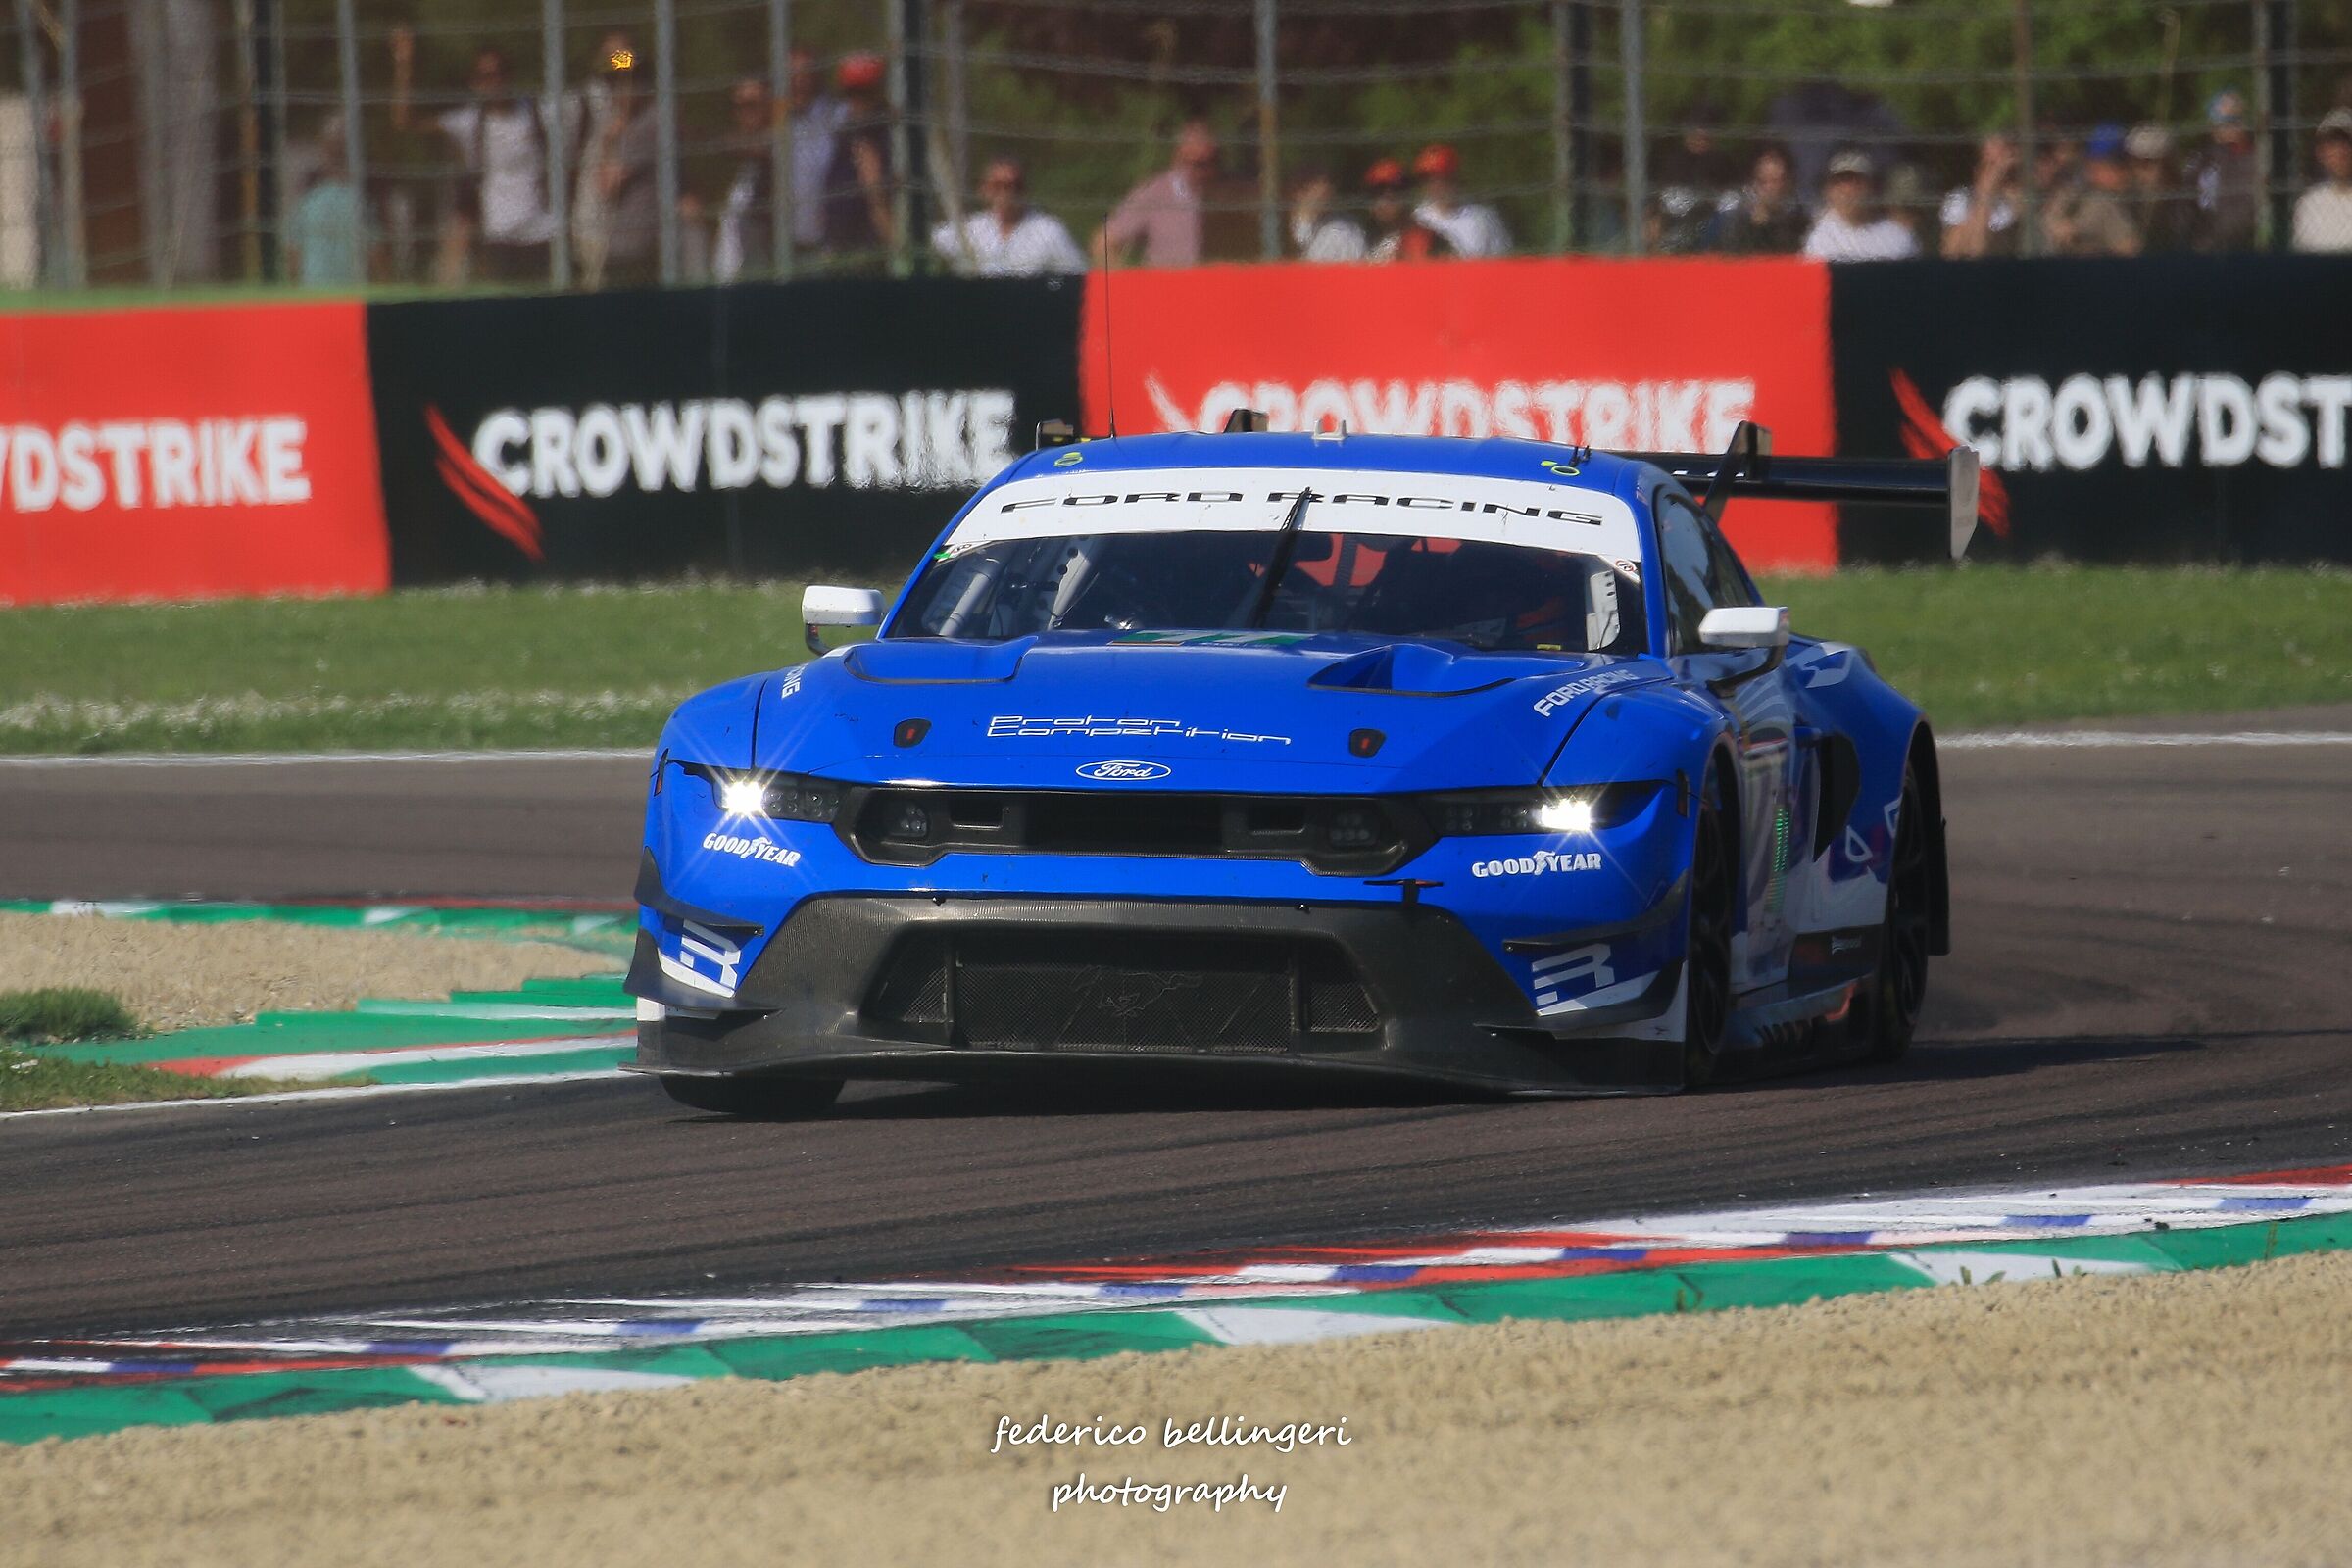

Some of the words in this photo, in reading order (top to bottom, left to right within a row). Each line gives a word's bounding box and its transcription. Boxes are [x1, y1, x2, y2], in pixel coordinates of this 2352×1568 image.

[471, 390, 1015, 497] CROWDSTRIKE
[0, 415, 312, 513] DSTRIKE
[1001, 491, 1244, 514] FORD
[1266, 492, 1603, 526] RACING
[1533, 682, 1590, 717] FORD
[987, 725, 1291, 746] Competition
[990, 714, 1180, 727] Proton
[1092, 760, 1153, 779] Ford
